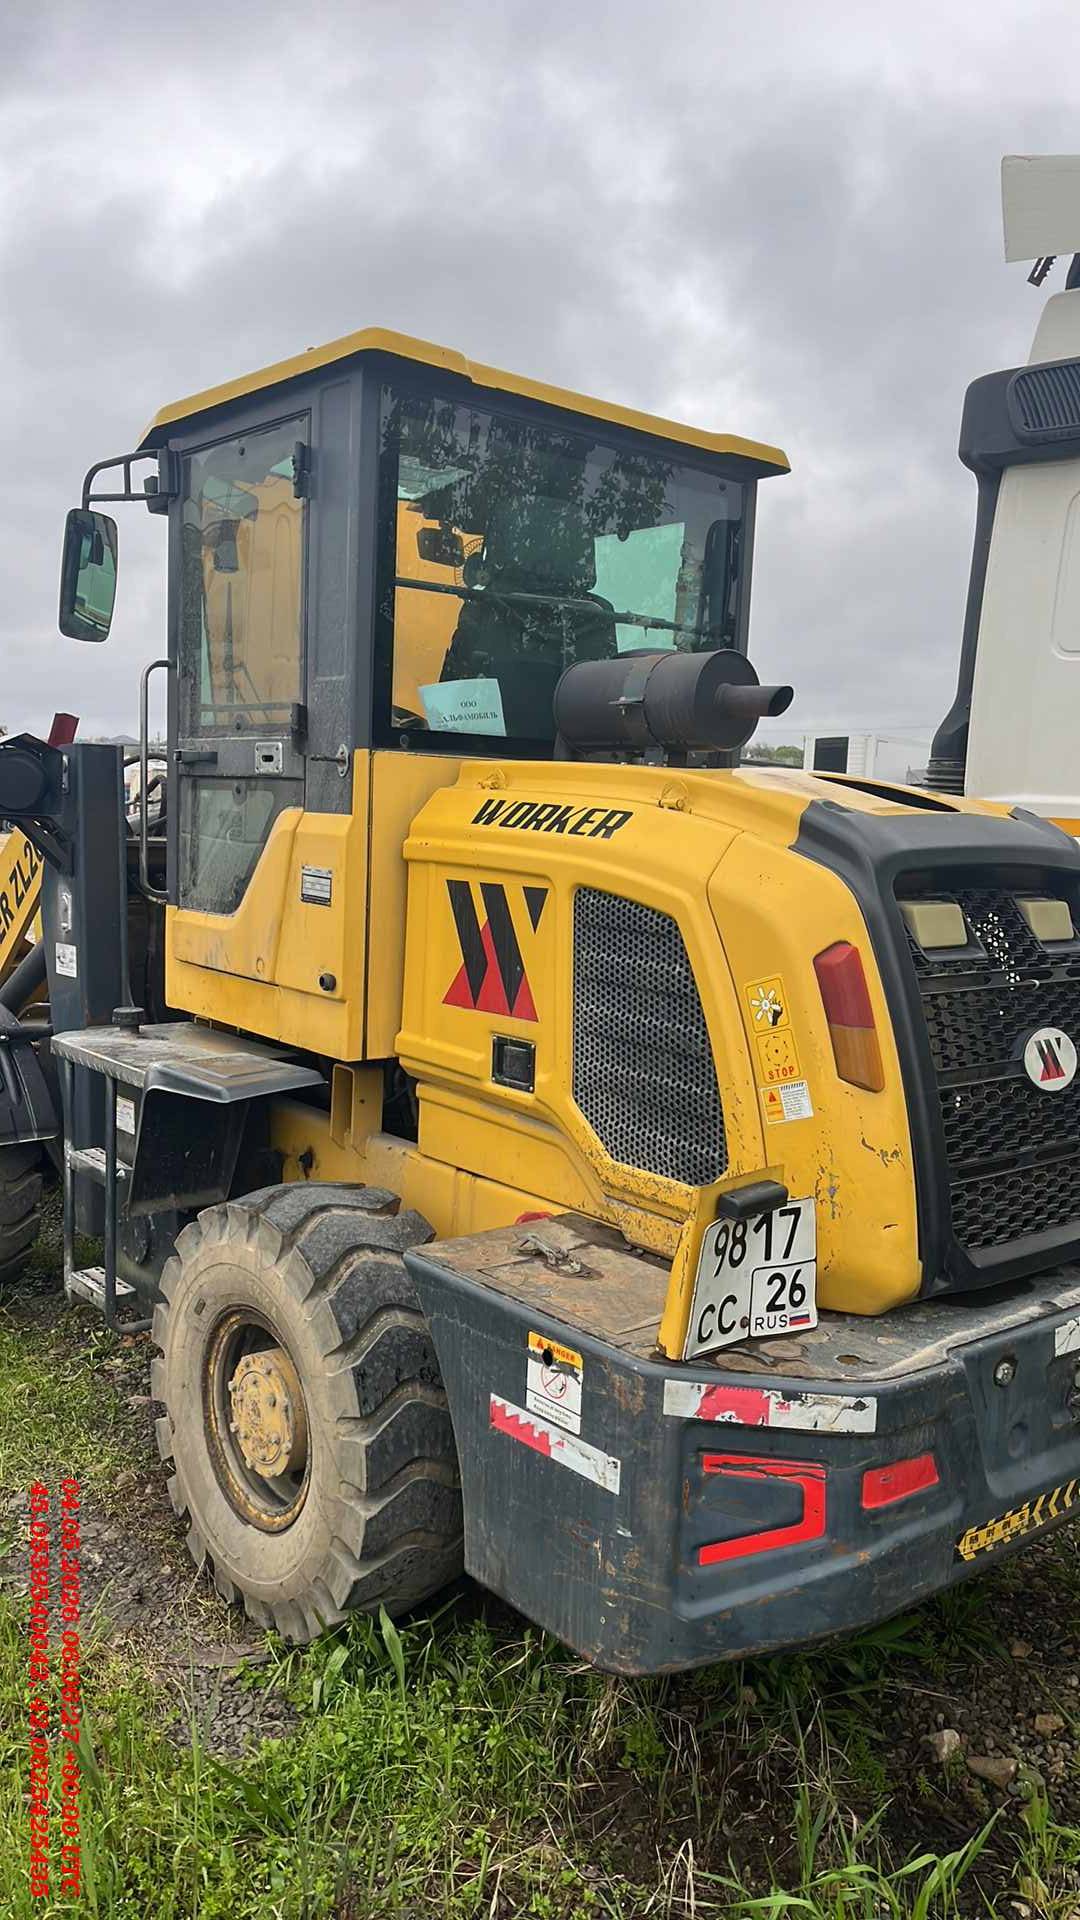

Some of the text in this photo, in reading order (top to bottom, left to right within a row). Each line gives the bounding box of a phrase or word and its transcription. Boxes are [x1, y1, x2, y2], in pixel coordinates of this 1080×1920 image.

[471, 799, 633, 839] WORKER
[9, 840, 43, 909] ZL2
[768, 1066, 795, 1080] STOP
[715, 1207, 801, 1278] 9817
[766, 1269, 806, 1312] 26
[755, 1315, 788, 1331] RUS
